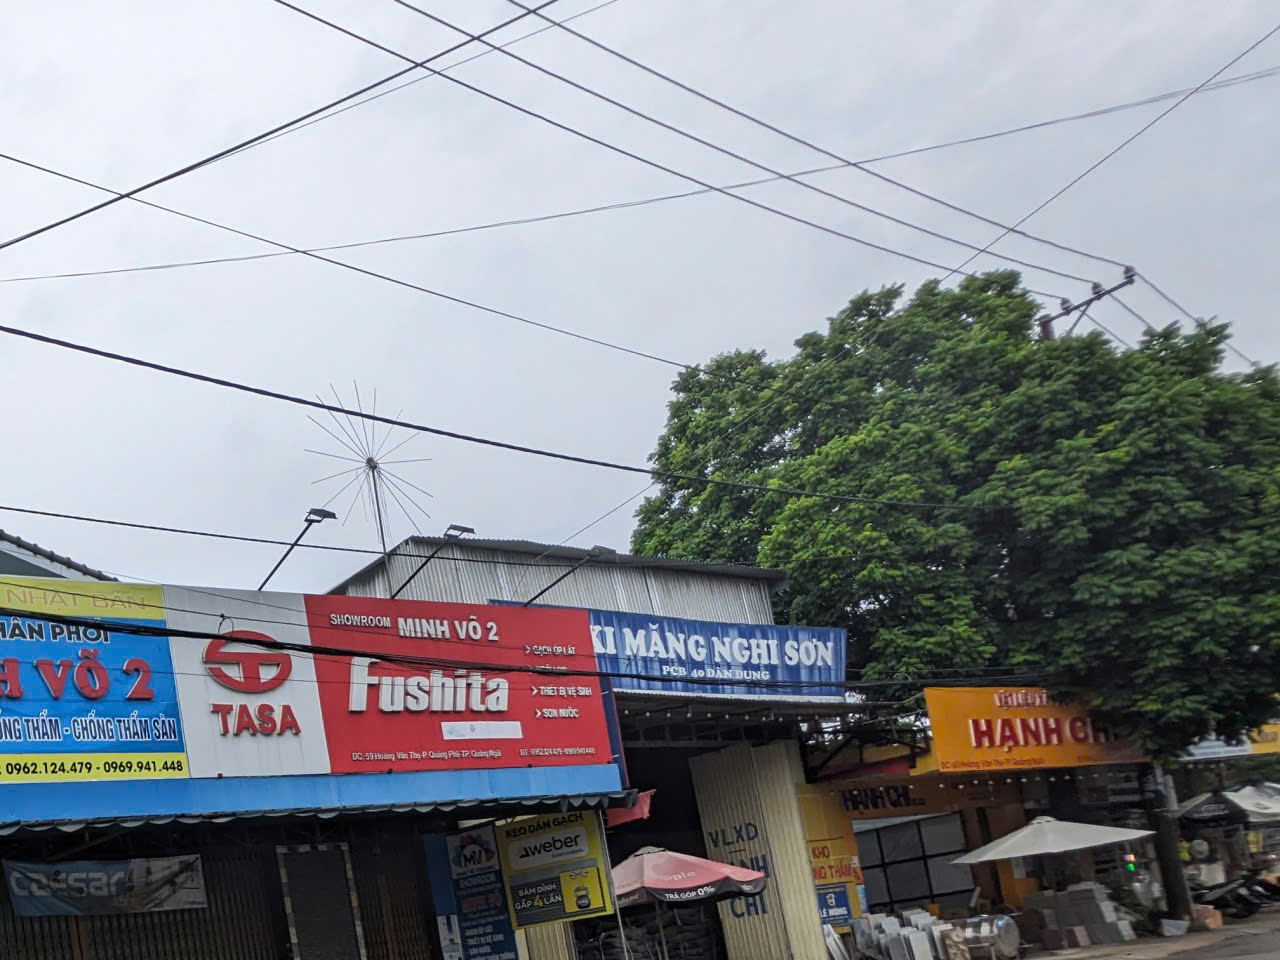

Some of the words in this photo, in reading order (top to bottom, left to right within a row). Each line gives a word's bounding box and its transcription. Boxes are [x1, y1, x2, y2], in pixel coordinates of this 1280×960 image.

[330, 613, 391, 628] SHOWROOM
[397, 617, 450, 640] MINH
[453, 615, 482, 640] VÕ
[487, 622, 499, 641] 2
[623, 622, 707, 662] MĂNG
[711, 636, 779, 665] NGHI
[784, 638, 834, 667] SƠN
[34, 648, 111, 700] VÕ
[122, 658, 155, 700] 2
[662, 665, 687, 676] PCB
[691, 669, 705, 678] 40
[348, 657, 509, 714] Fushita
[24, 710, 62, 741] THẤM
[72, 710, 114, 741] CHỐNG
[116, 709, 151, 741] THẤM
[152, 713, 178, 741] SÀN
[209, 702, 301, 736] TASA
[969, 717, 1063, 752] HẠNH
[6, 762, 93, 775] 0962.124.479
[104, 760, 183, 773] 0969.941.448
[529, 834, 580, 857] weber
[708, 822, 758, 848] VLXD
[811, 845, 830, 860] KHO
[533, 895, 544, 907] 4
[680, 890, 696, 899] GÓP
[697, 885, 716, 896] 0%
